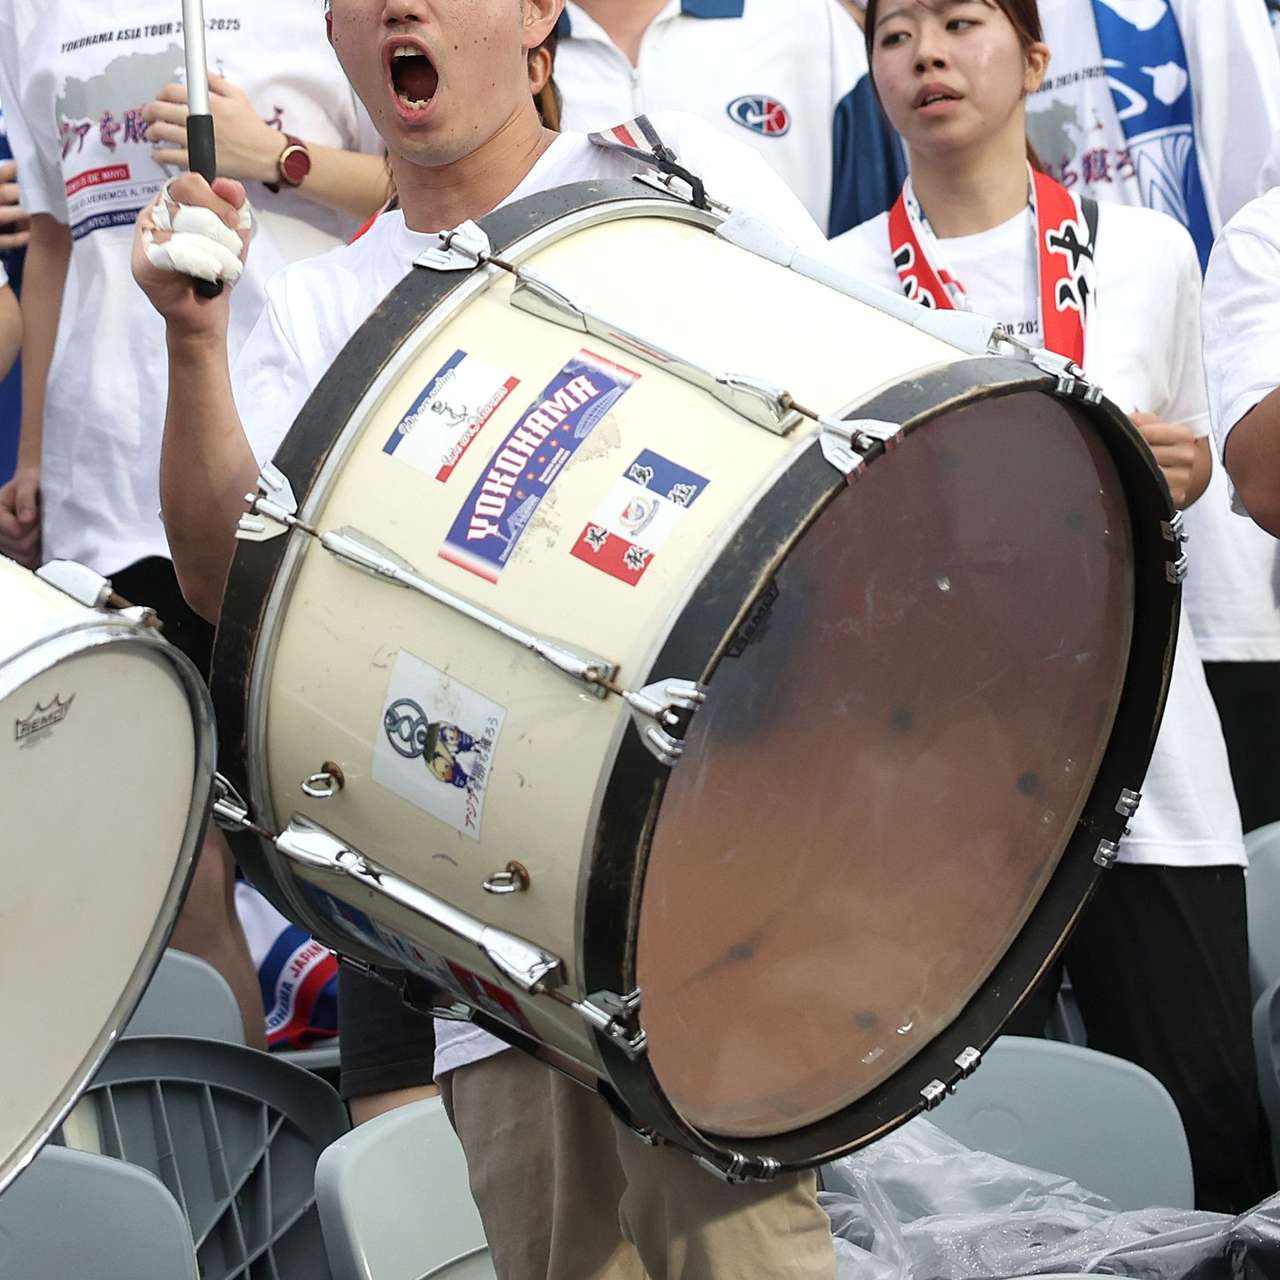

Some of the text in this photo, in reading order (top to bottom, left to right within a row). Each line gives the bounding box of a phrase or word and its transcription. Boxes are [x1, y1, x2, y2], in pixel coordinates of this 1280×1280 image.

[61, 31, 114, 53] YOKOHAMA
[116, 26, 141, 41] ASIA
[144, 22, 173, 37] TOUR
[467, 373, 600, 541] YOKOHAMA
